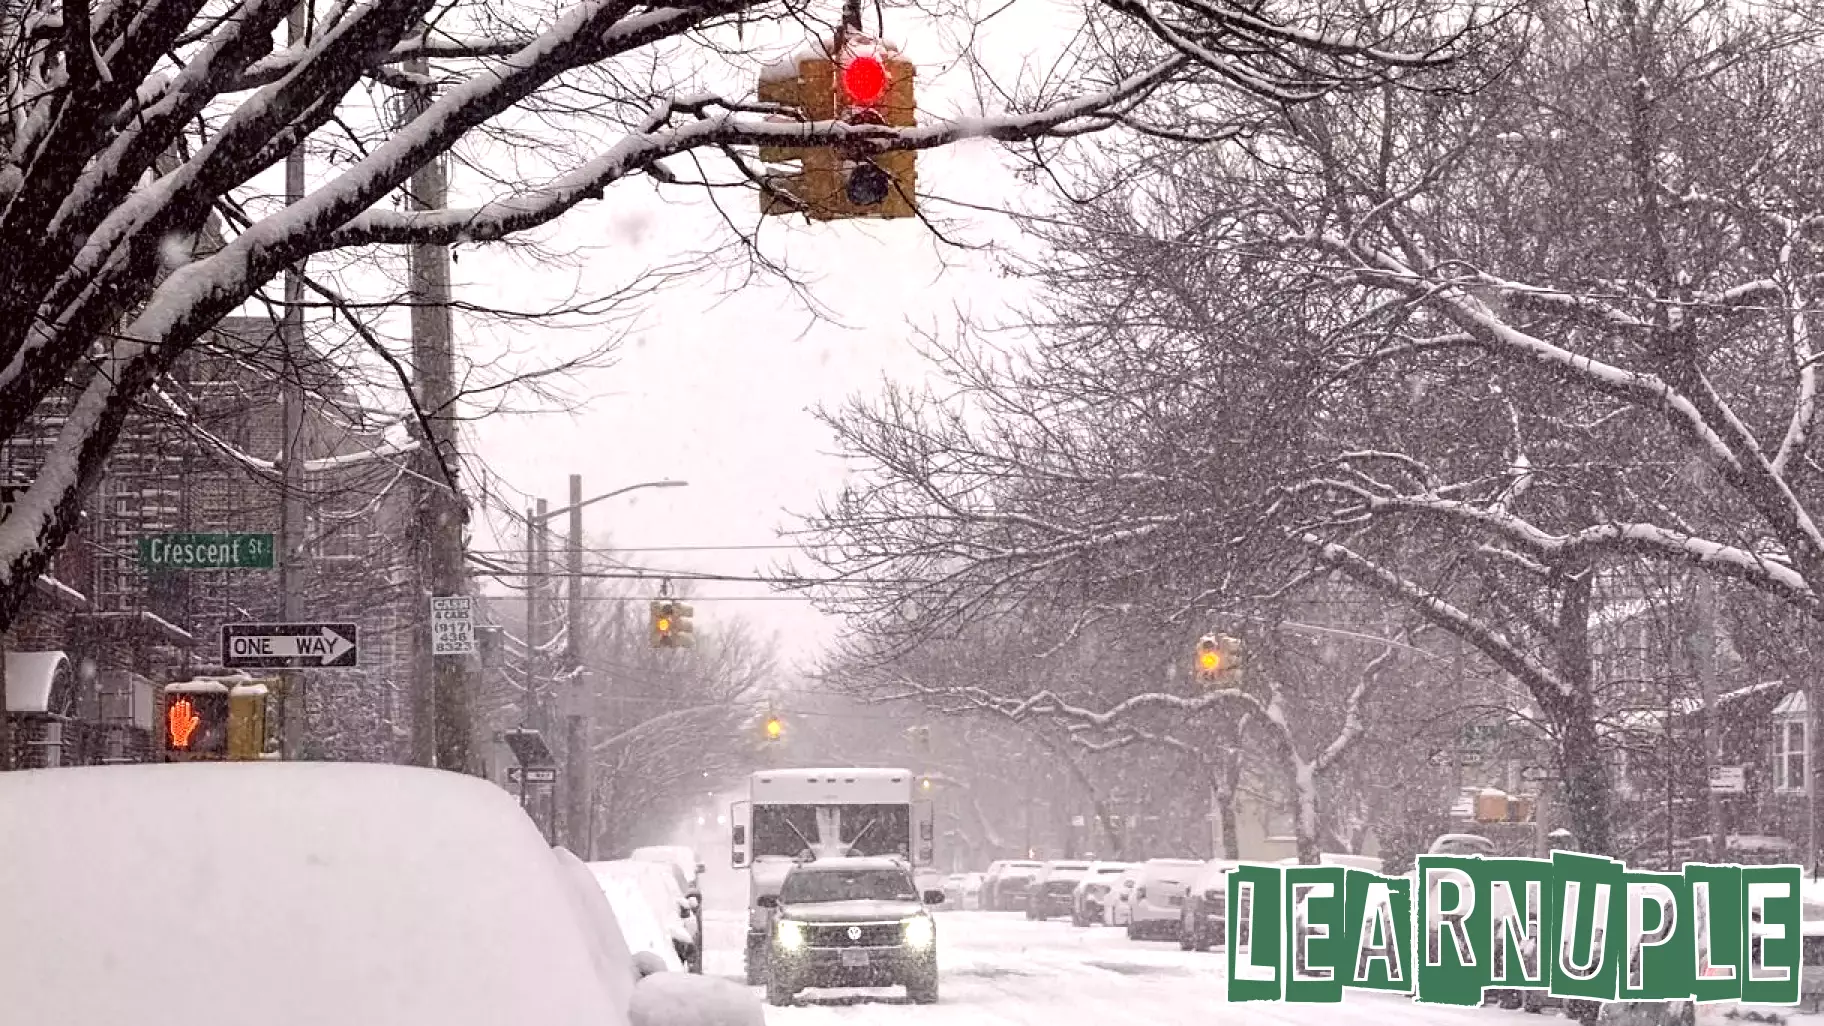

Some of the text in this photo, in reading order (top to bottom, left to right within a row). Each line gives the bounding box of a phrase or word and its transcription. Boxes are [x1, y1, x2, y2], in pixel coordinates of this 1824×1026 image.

[150, 538, 240, 563] Crescent
[435, 622, 471, 633] (917)
[234, 638, 338, 654] ONE WAY
